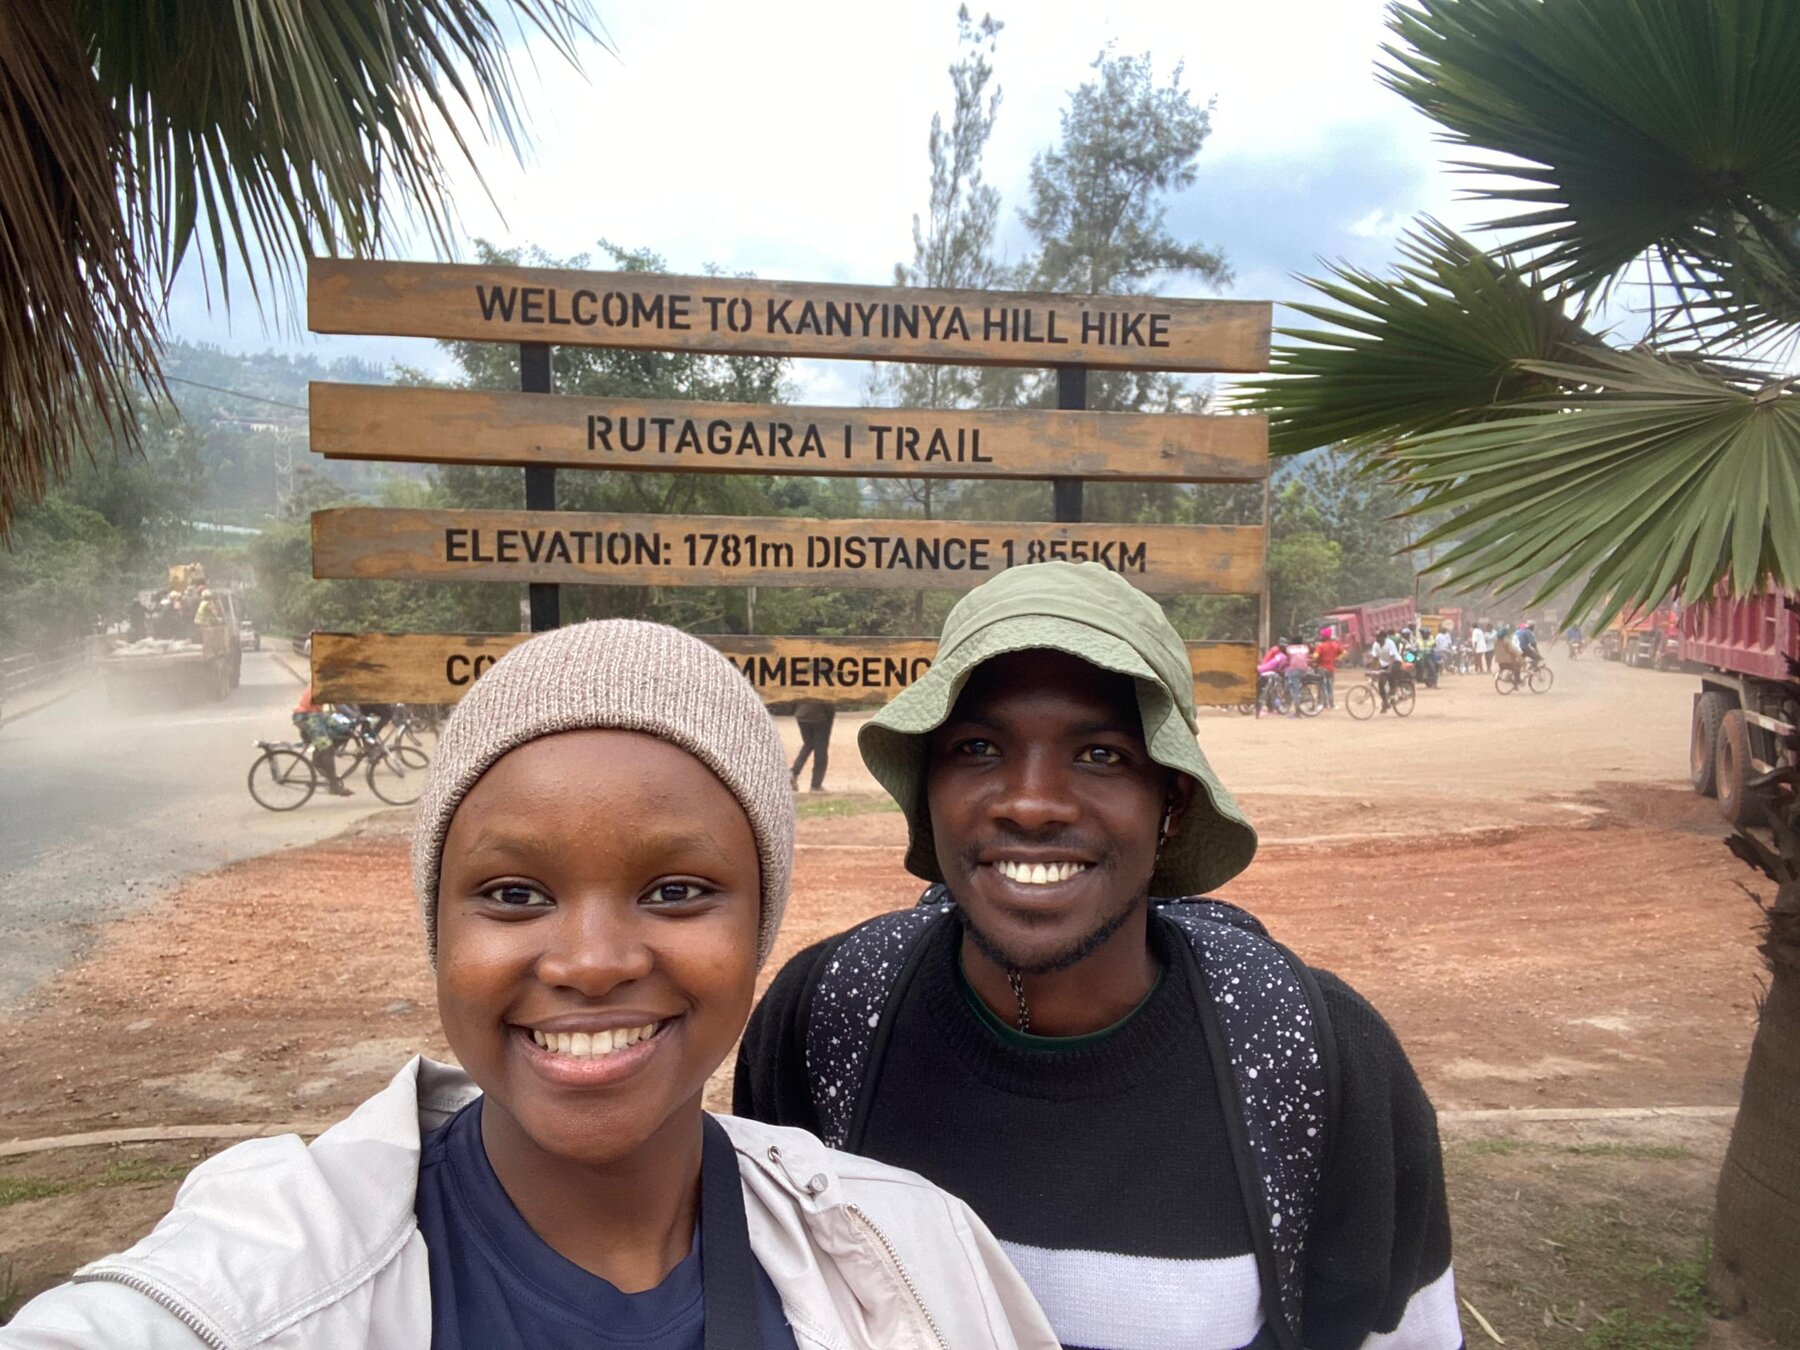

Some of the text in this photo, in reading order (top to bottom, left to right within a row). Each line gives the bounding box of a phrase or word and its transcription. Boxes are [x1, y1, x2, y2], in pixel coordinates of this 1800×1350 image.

[475, 285, 1171, 348] WELCOME TO KANYINYA HILL HIKE
[587, 415, 827, 459] RUTAGARA
[868, 425, 993, 463] TRAIL
[445, 528, 1147, 573] ELEVATION: 1781m DISTANCE 1855KM
[728, 656, 932, 688] MMERGENC
